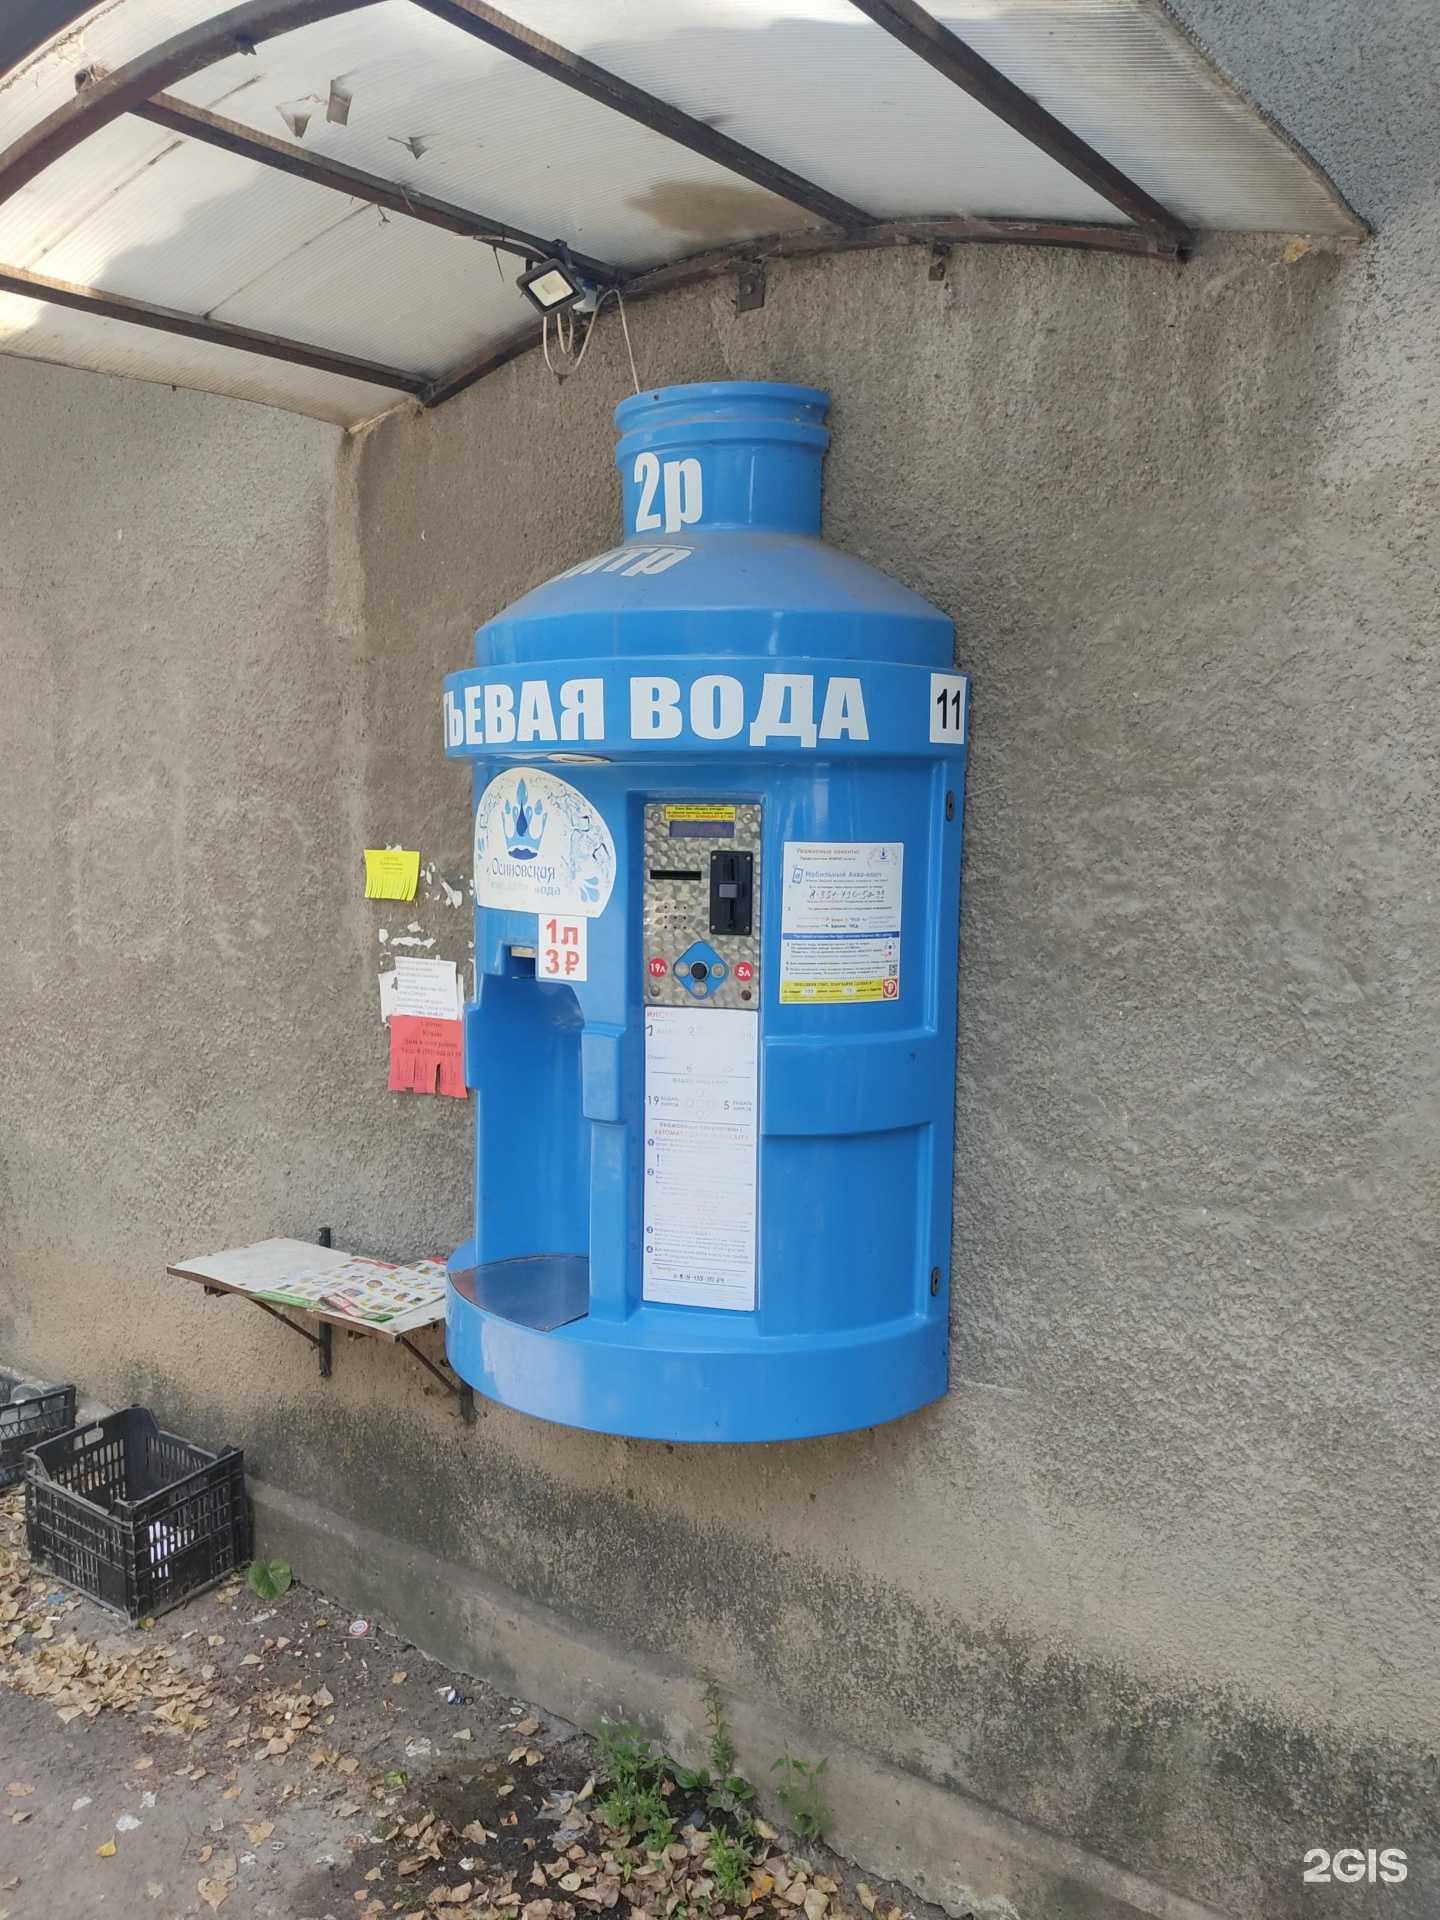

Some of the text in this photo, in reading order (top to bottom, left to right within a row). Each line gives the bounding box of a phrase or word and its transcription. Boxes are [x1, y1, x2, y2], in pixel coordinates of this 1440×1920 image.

[634, 452, 703, 533] 2р
[630, 673, 870, 748] ВОДА
[936, 688, 962, 732] 11
